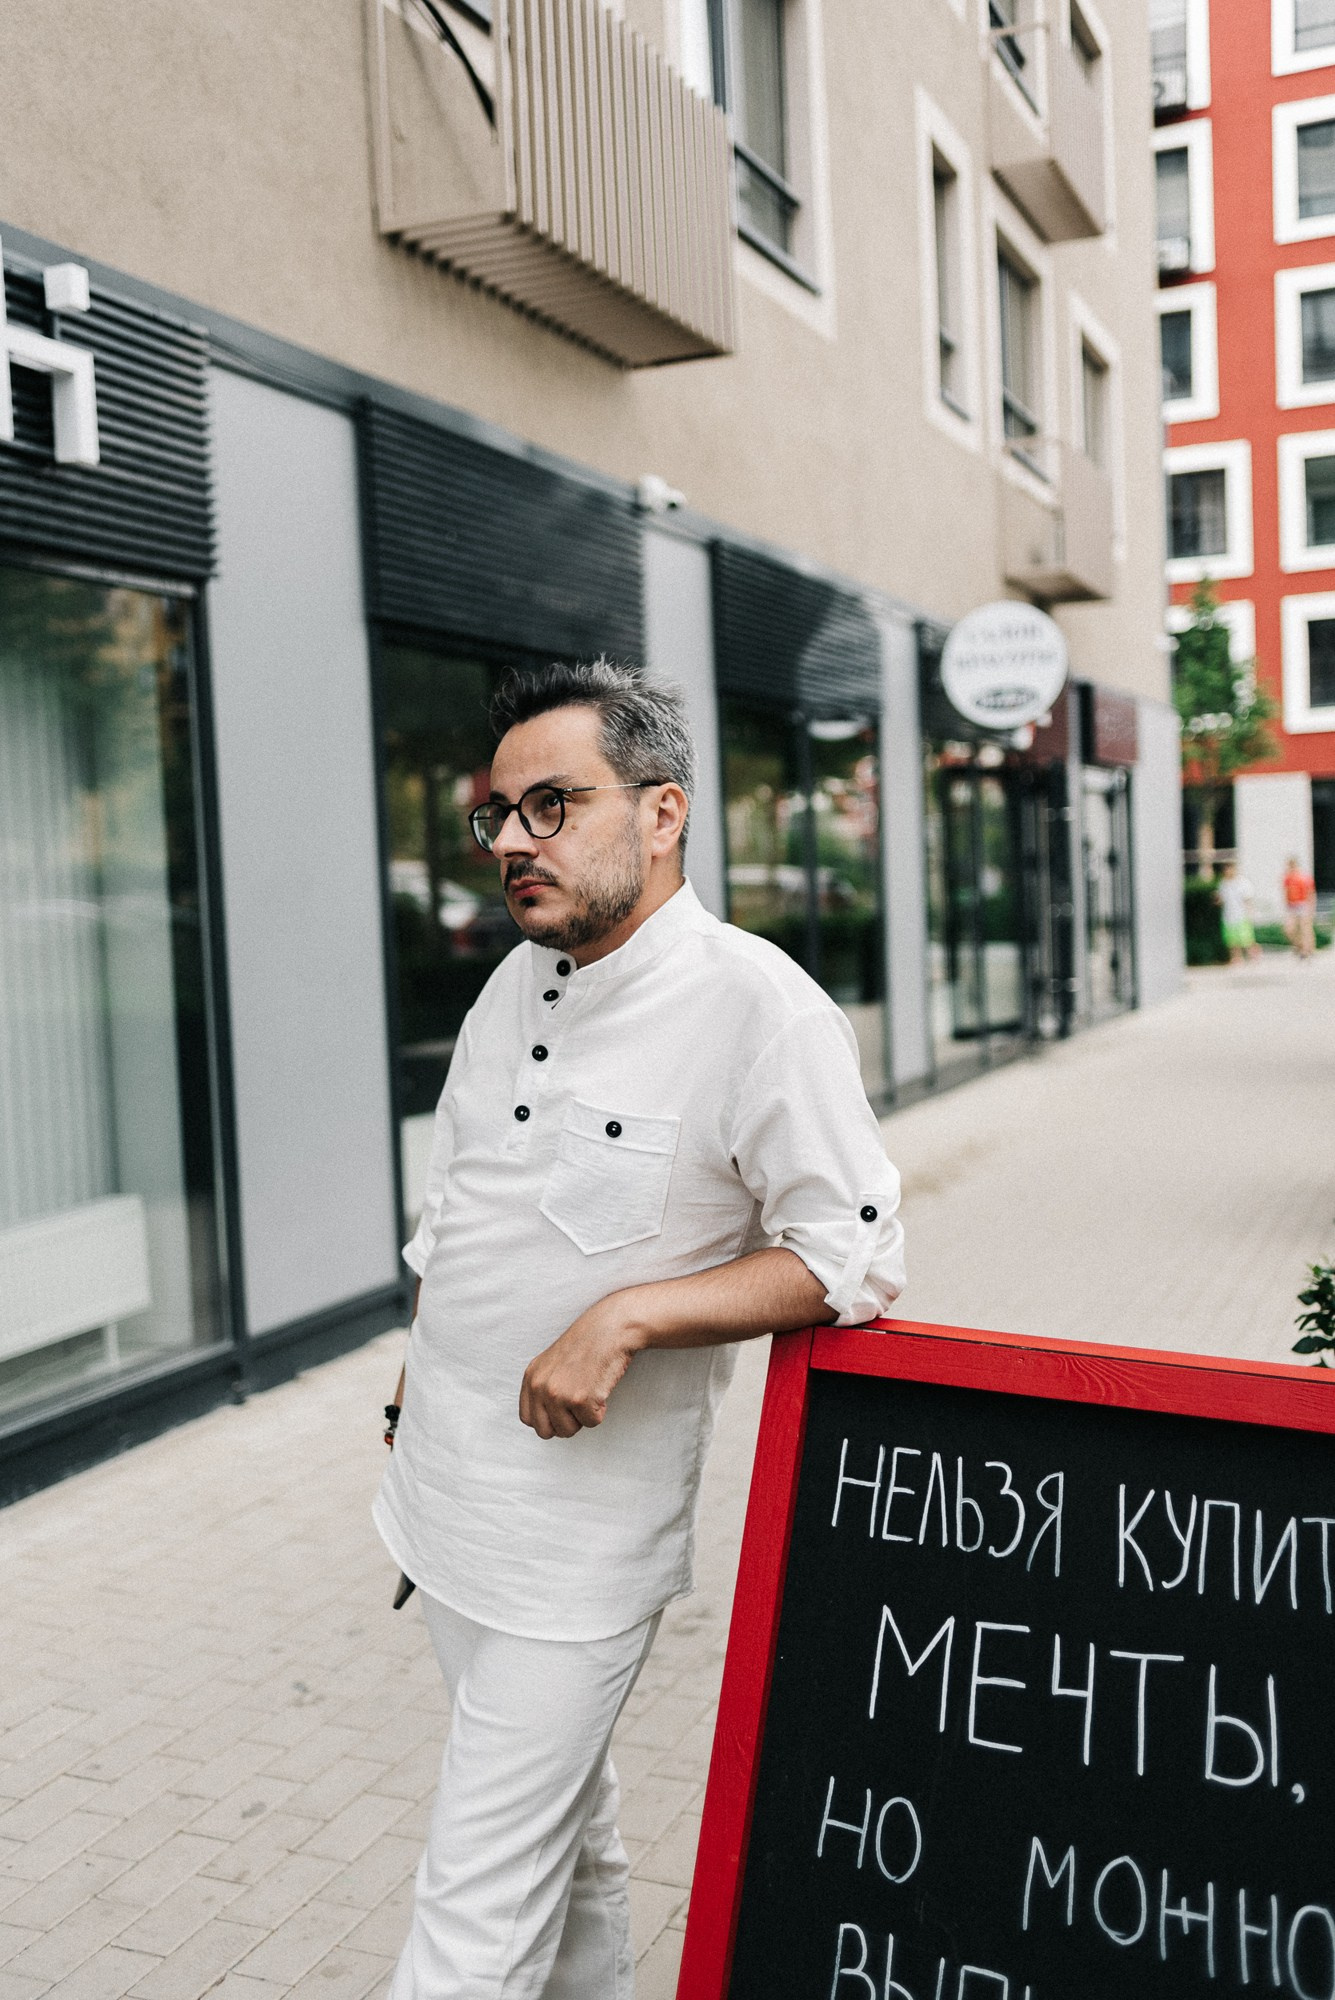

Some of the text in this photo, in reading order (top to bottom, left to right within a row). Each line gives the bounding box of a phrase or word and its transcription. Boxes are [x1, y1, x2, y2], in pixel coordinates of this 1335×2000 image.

[830, 1437, 1335, 1615] НЕЛЬЗЯ КУПИТ
[868, 1604, 1306, 1804] МЕЧТЫ,
[816, 1775, 1335, 2000] НО МОЖНО
